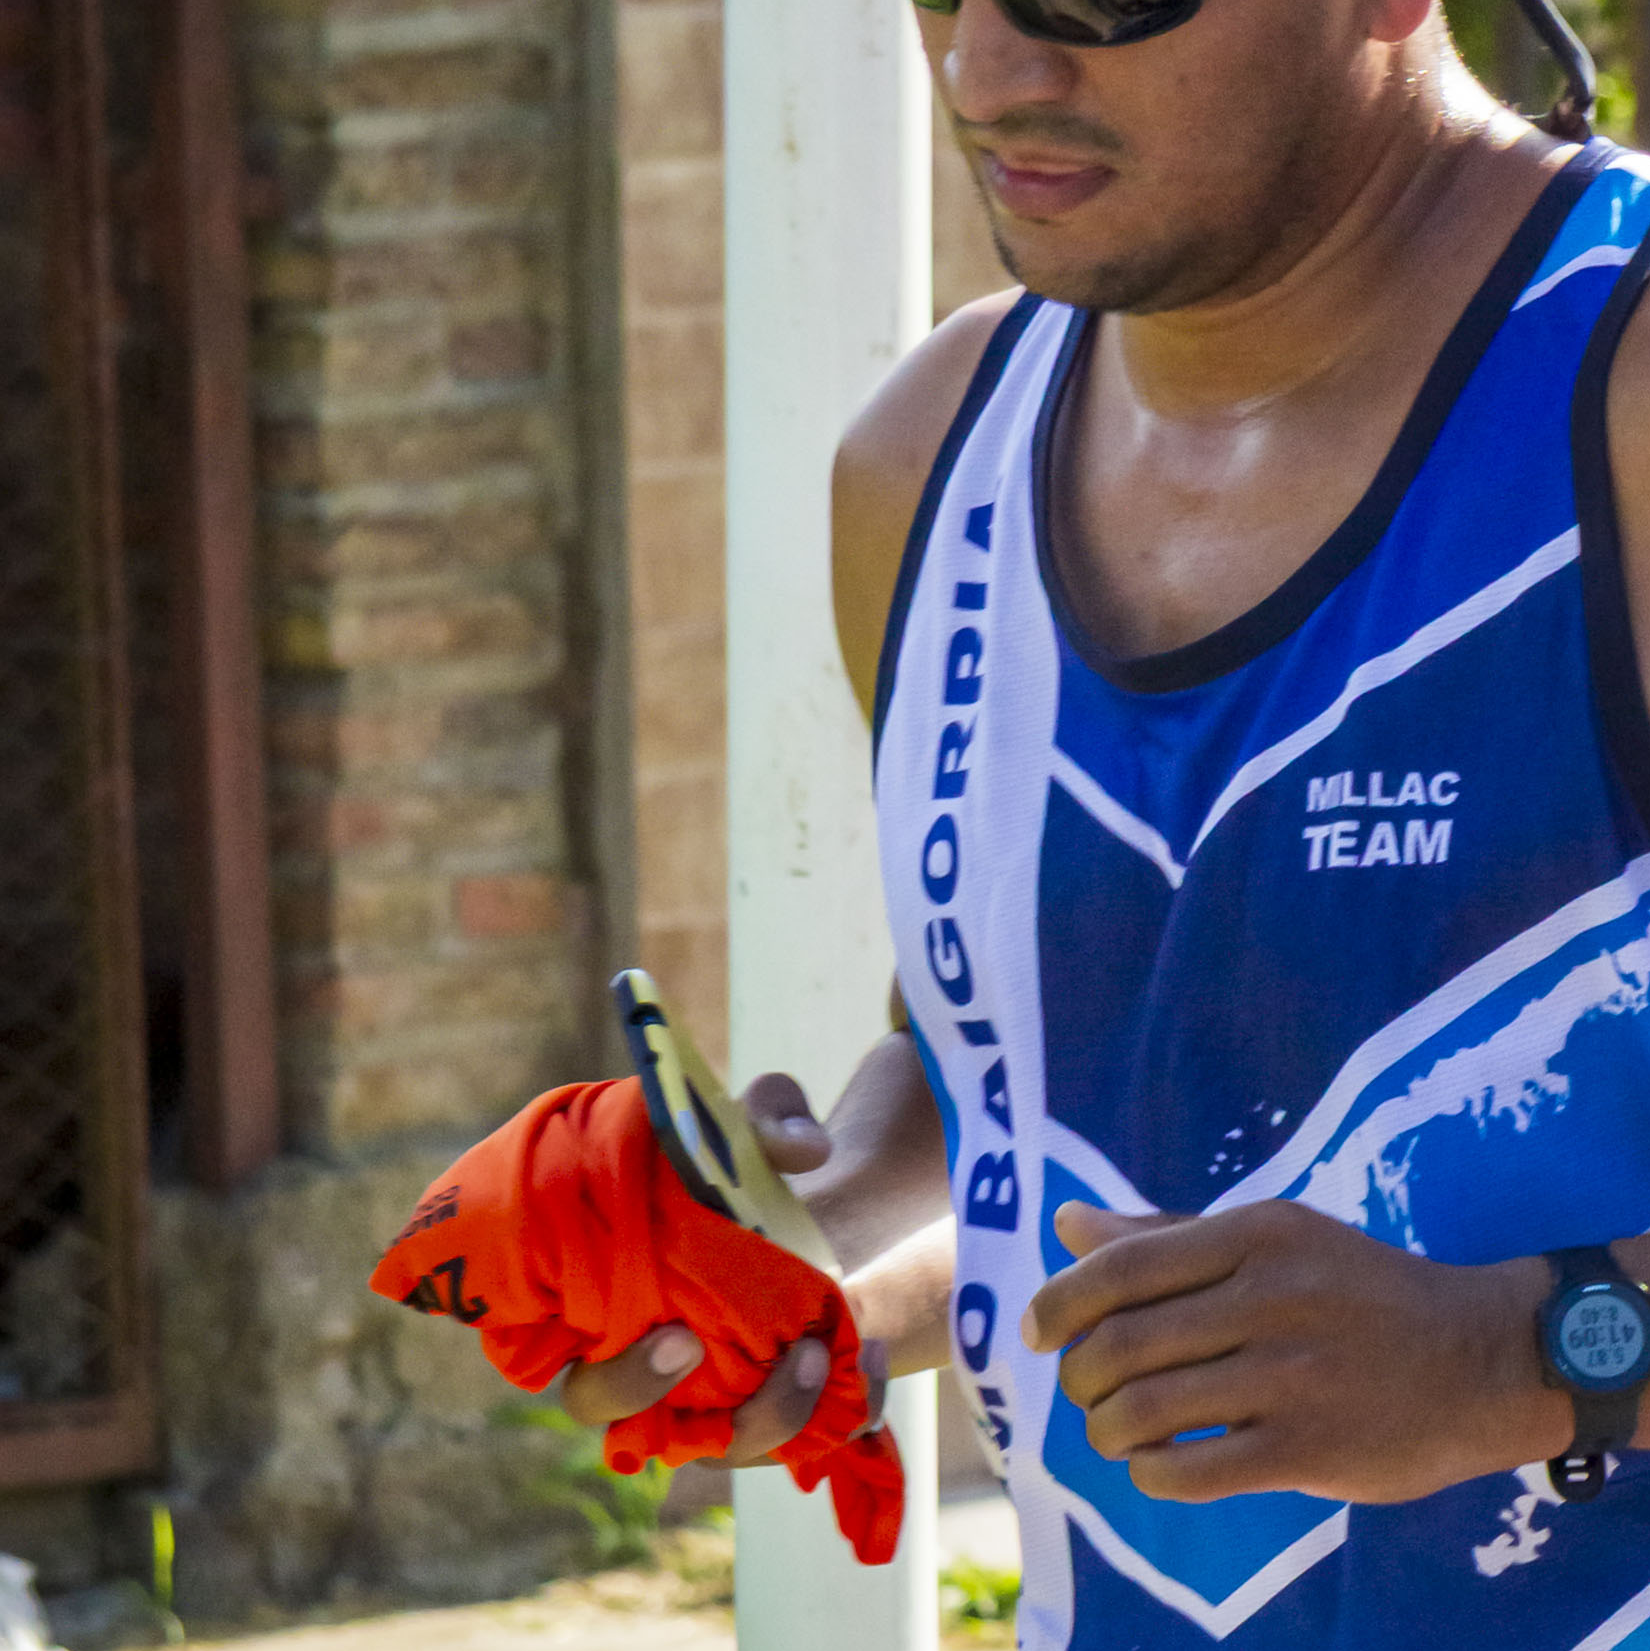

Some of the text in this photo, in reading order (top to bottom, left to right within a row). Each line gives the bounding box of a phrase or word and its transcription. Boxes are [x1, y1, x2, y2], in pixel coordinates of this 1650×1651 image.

[1305, 770, 1462, 813] MLLAC
[1302, 818, 1454, 872] TEAM
[1567, 1323, 1637, 1350] 41:09
